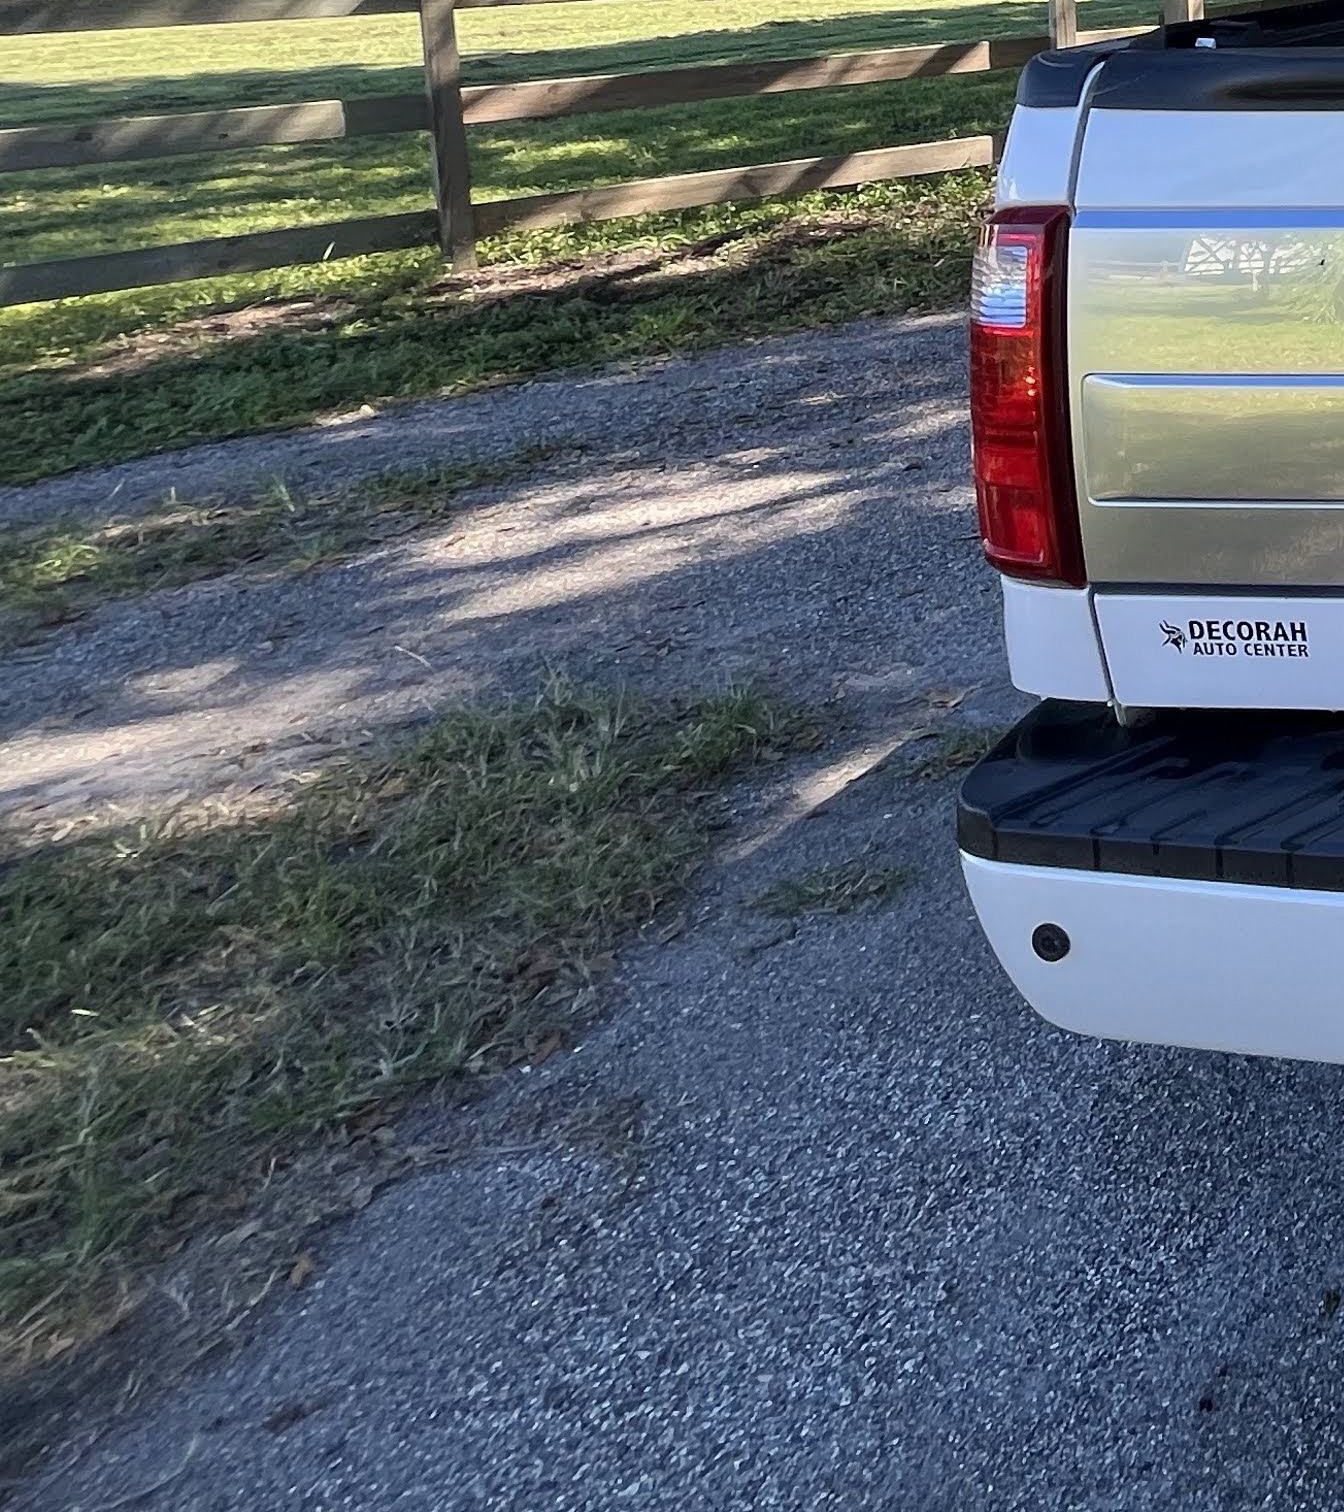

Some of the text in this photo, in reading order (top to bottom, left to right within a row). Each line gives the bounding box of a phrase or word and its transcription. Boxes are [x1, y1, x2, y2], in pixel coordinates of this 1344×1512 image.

[1188, 620, 1308, 642] DECORAH
[1193, 642, 1309, 658] AUTO CENTER
